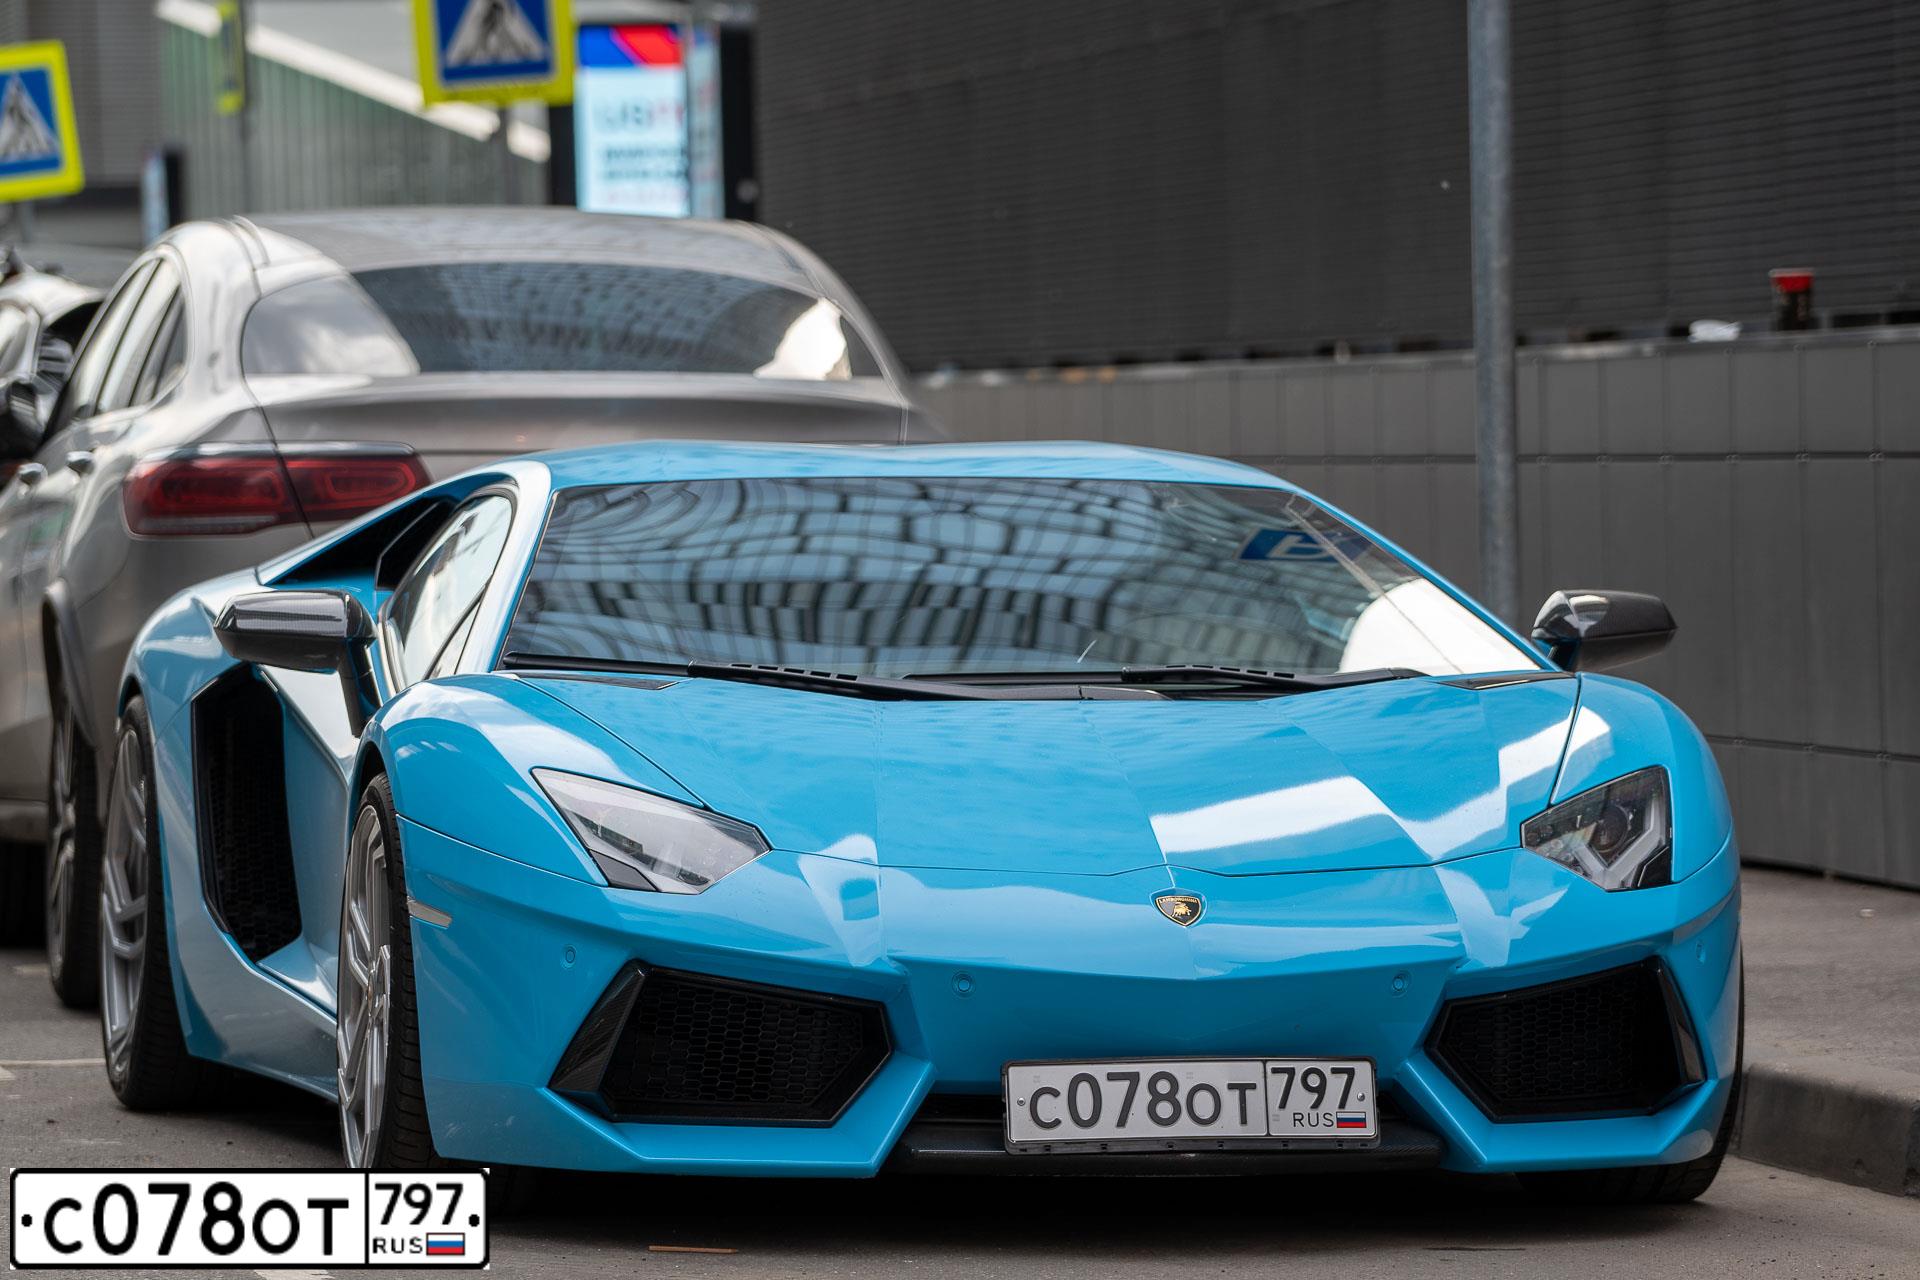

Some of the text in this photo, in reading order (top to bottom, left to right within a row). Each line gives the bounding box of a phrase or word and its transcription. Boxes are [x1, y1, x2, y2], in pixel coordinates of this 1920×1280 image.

[1029, 1066, 1356, 1130] C078OT 797
[1292, 1110, 1335, 1128] RUS
